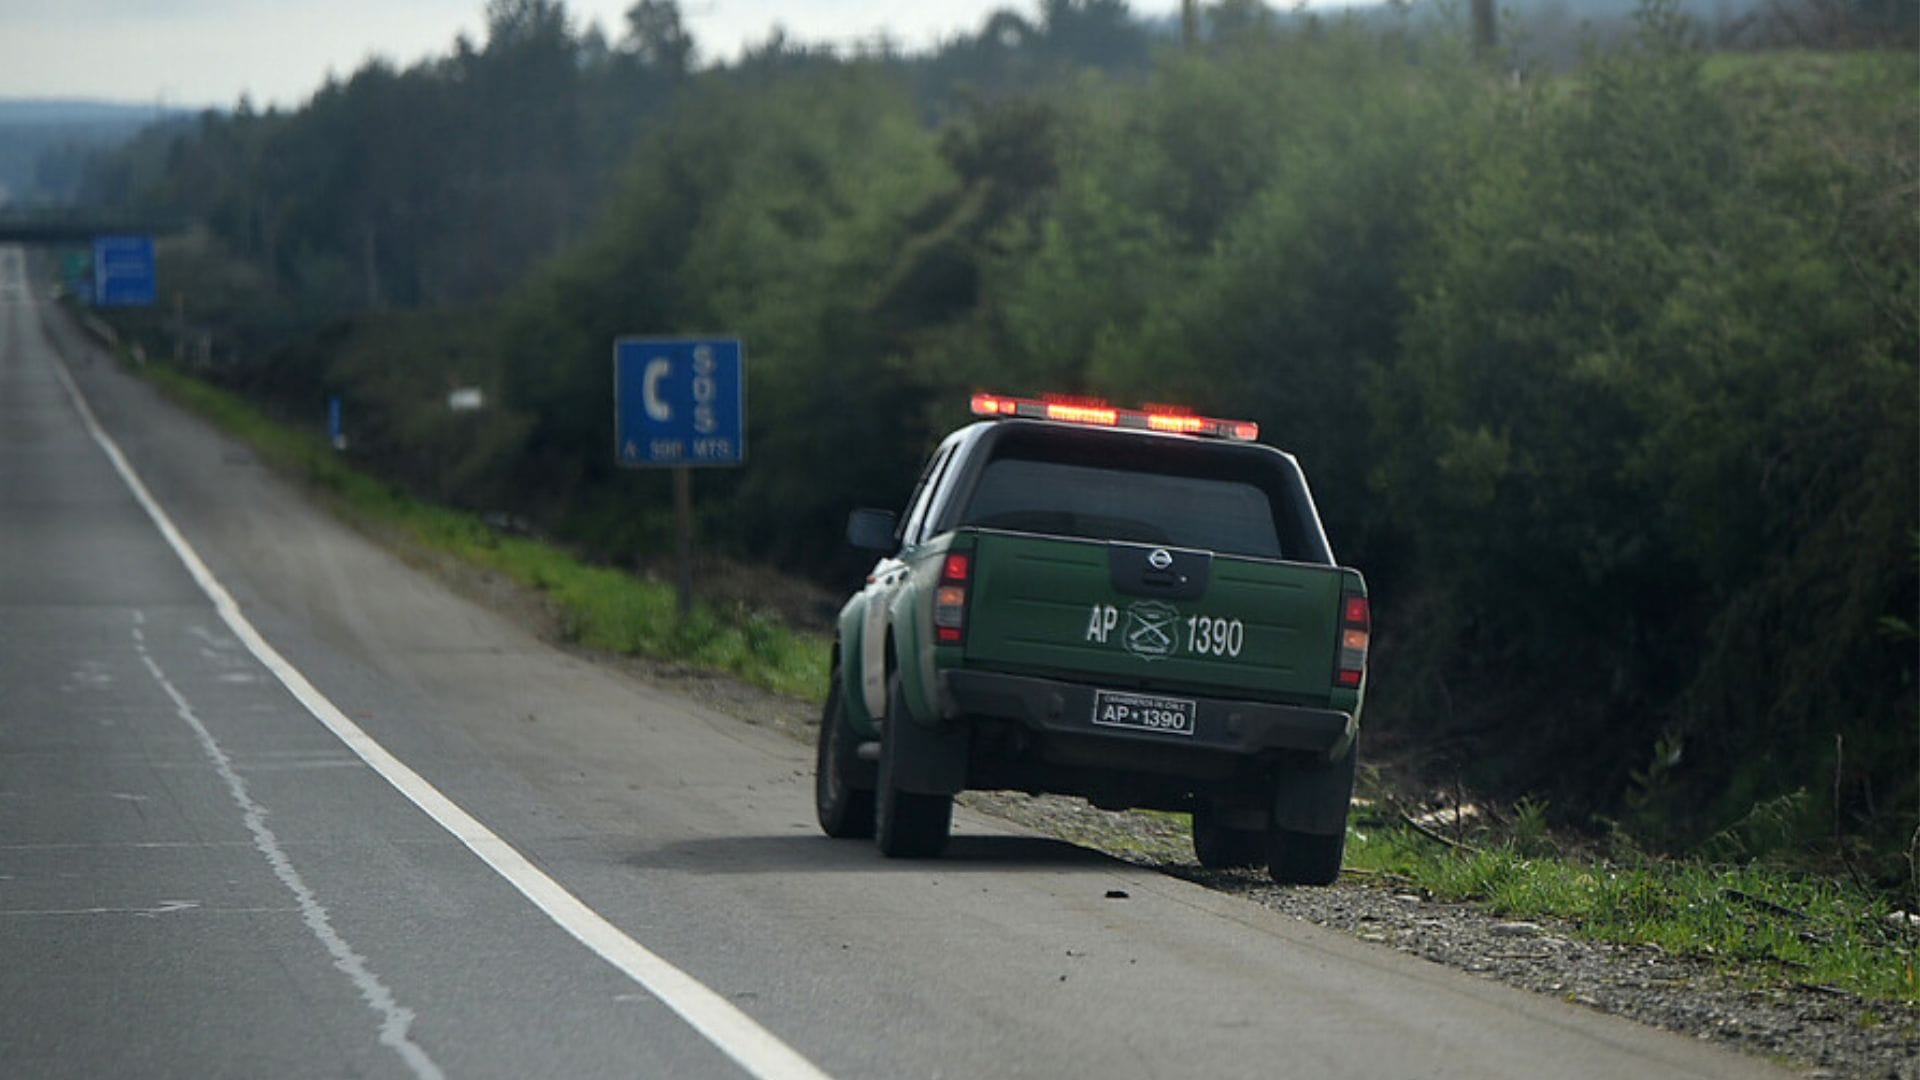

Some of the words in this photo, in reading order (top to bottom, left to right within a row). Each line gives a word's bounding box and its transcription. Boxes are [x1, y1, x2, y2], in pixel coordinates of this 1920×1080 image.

[693, 345, 715, 433] SOS
[1087, 604, 1118, 643] AP
[1187, 615, 1243, 657] 1390
[1141, 709, 1185, 729] 1390
